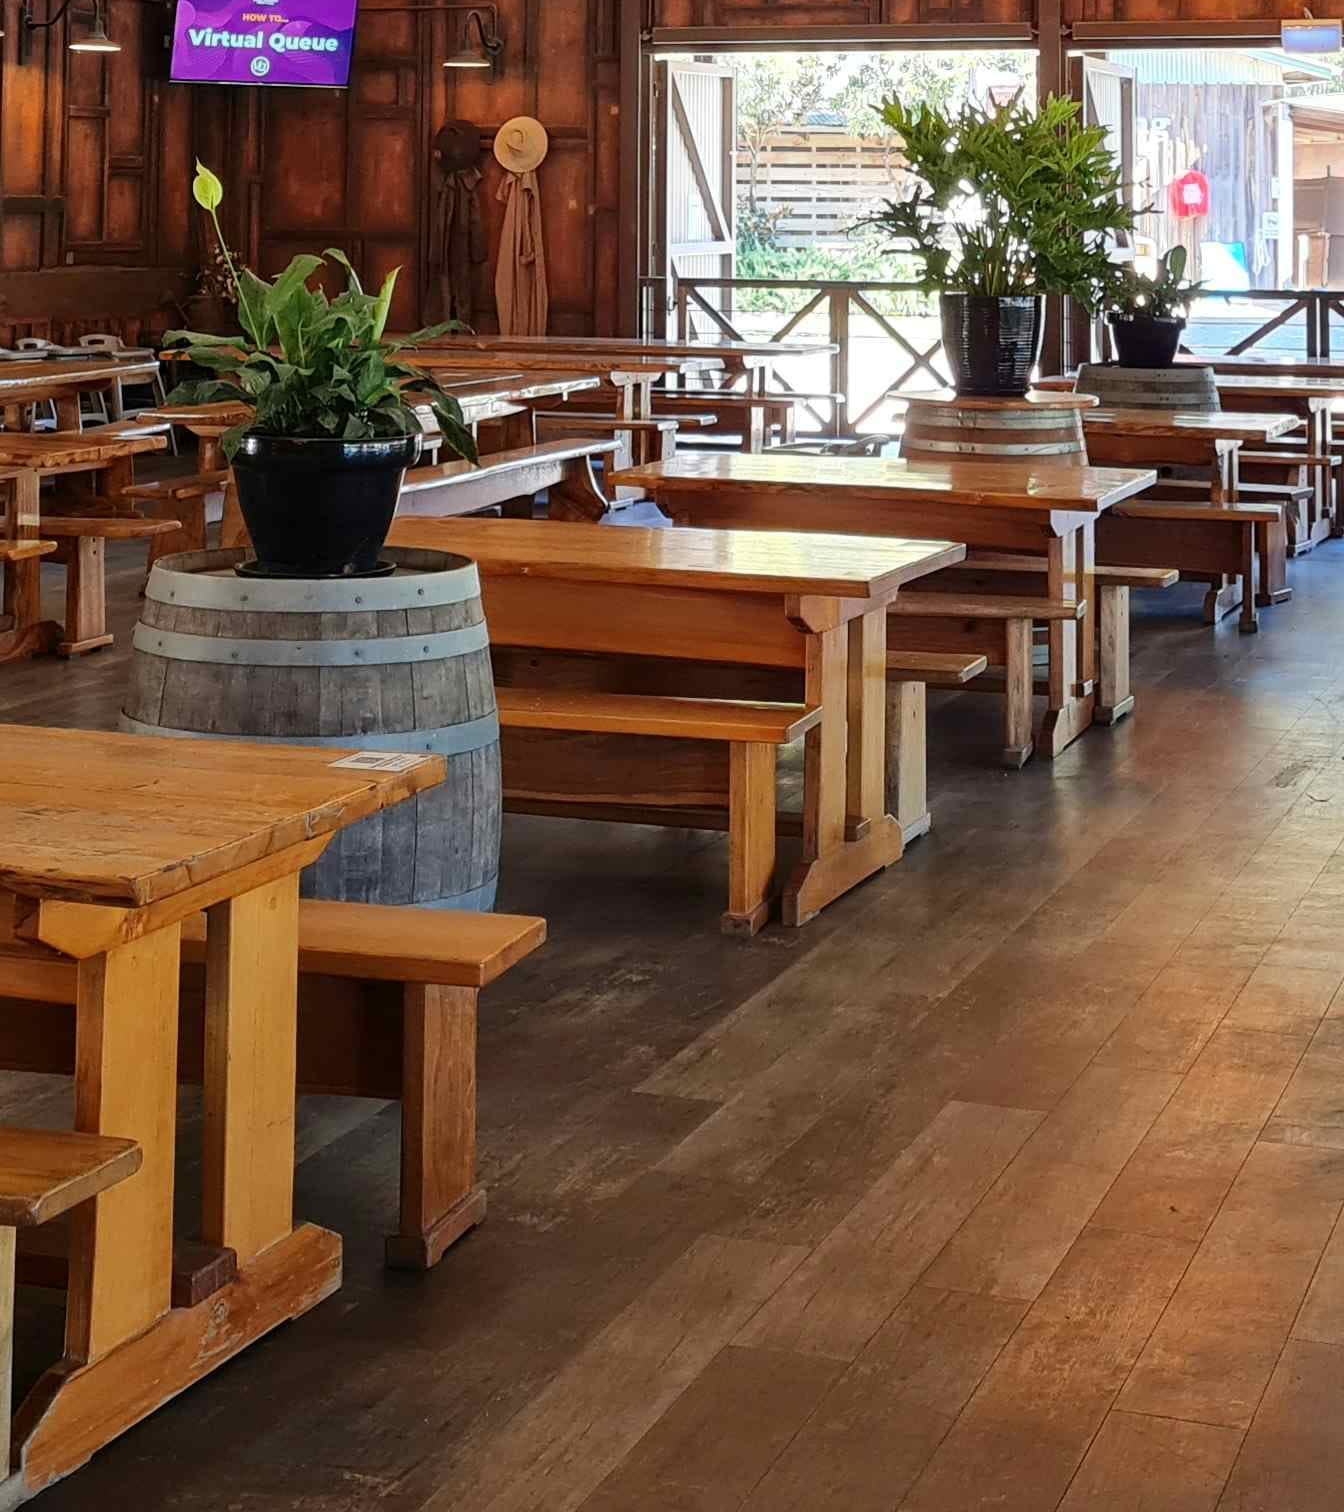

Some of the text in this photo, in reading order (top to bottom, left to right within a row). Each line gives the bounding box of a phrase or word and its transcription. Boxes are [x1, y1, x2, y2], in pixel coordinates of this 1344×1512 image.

[242, 12, 267, 22] HOW
[188, 27, 339, 53] Virtual Queue
